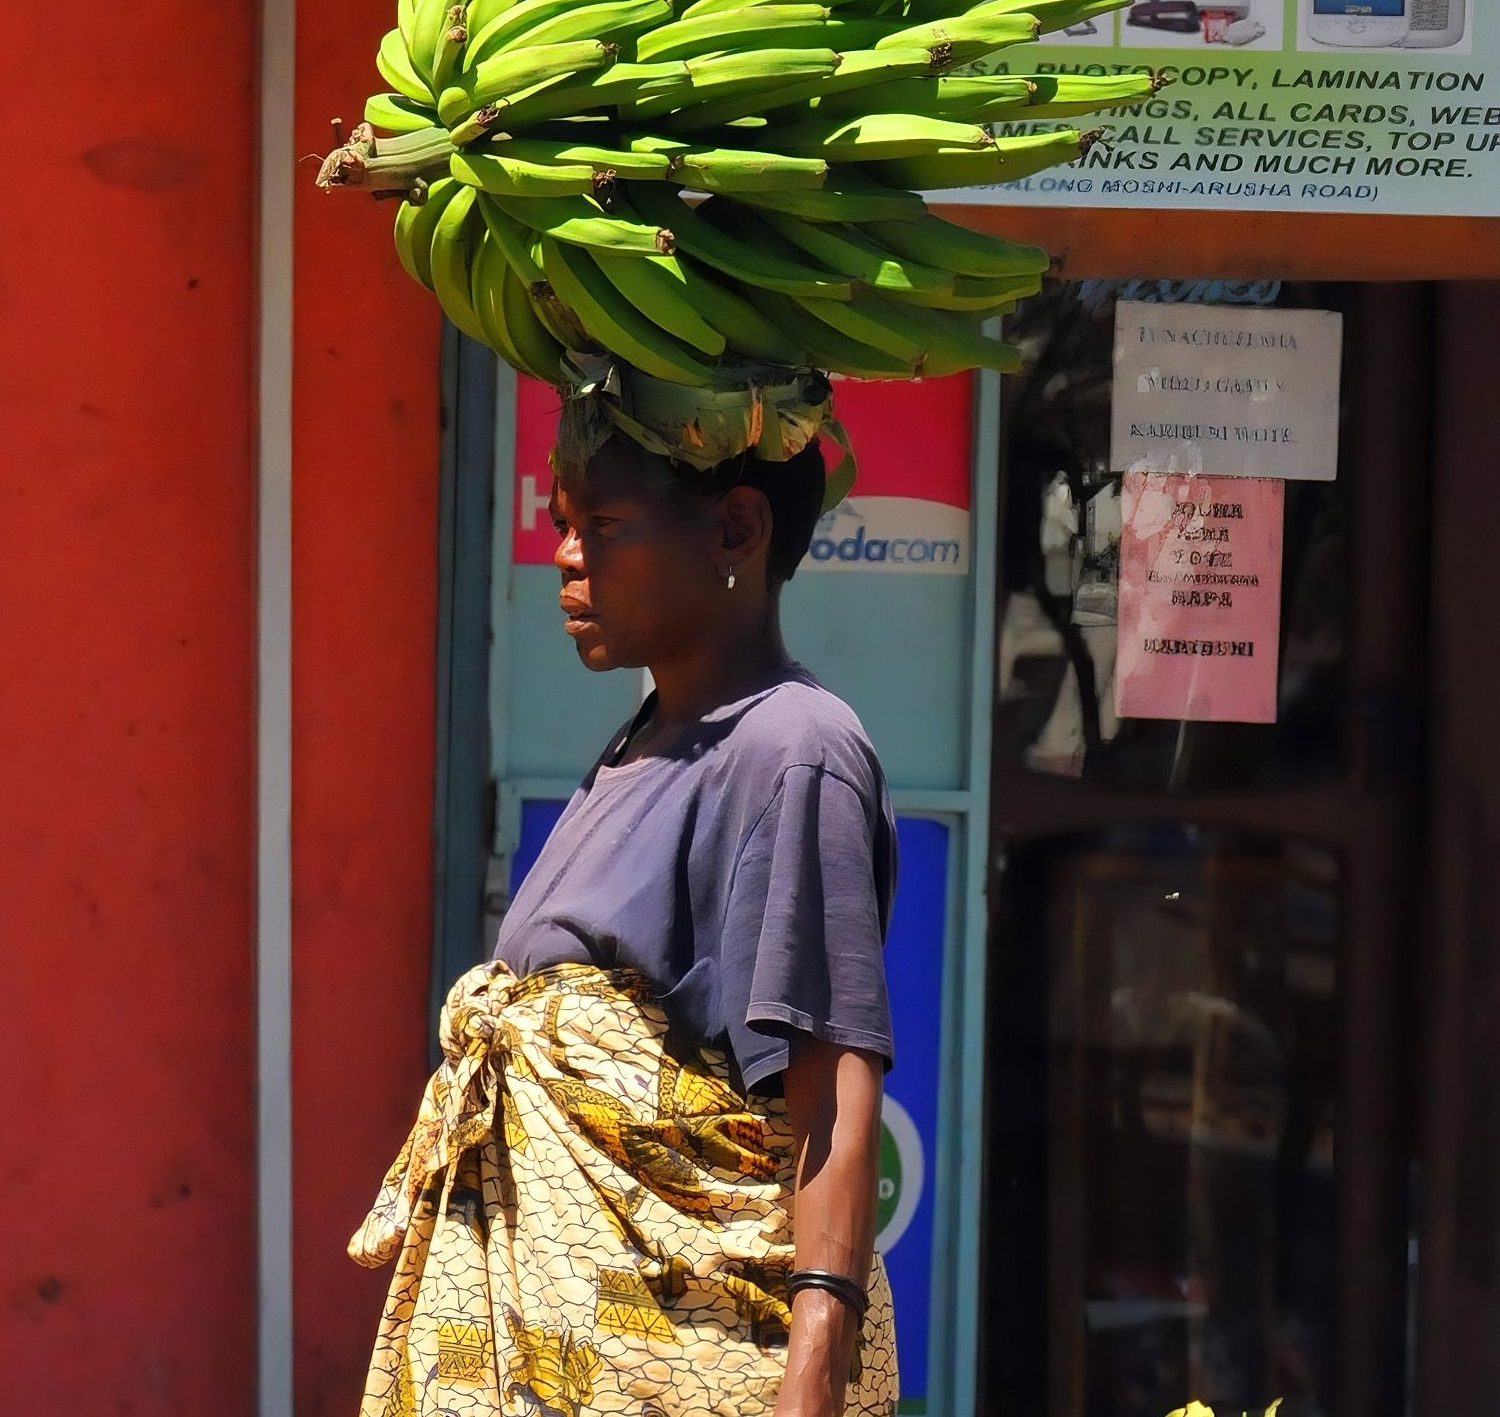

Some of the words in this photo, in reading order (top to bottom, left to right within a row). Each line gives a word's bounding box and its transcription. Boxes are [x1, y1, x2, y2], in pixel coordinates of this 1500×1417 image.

[1271, 68, 1485, 92] LAMINATION
[1212, 101, 1277, 122] ALL
[1289, 102, 1416, 128] CARDS,
[1194, 126, 1373, 152] SERVICES,
[1390, 131, 1455, 151] TOP
[1169, 151, 1243, 172] AND
[1253, 154, 1363, 175] MUCH
[1364, 156, 1474, 178] MORE.
[1301, 183, 1379, 202] ROAD)
[809, 525, 960, 564] odacom
